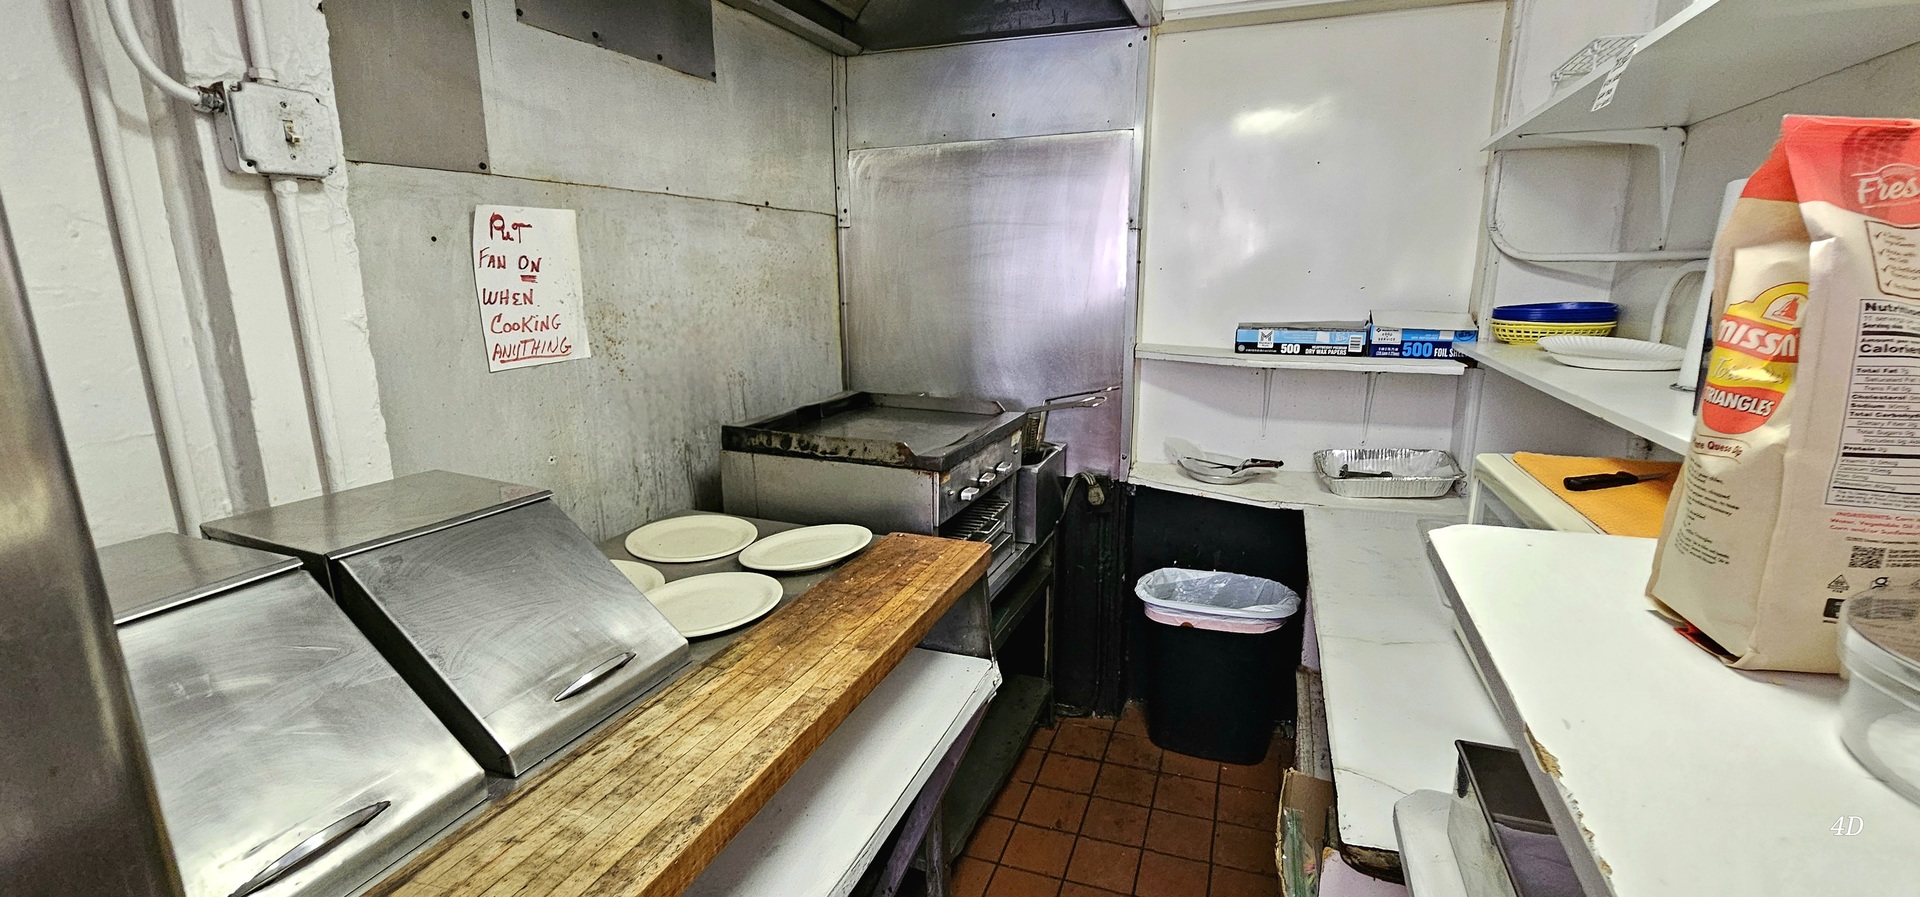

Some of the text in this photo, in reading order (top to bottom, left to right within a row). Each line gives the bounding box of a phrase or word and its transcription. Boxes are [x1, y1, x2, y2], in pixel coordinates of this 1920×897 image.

[478, 246, 542, 273] FAN ON
[482, 288, 534, 306] WHEN
[1281, 343, 1301, 354] 500
[1402, 342, 1434, 357] 500
[1434, 348, 1449, 357] FOIL
[1704, 385, 1776, 417] TRIANGLES
